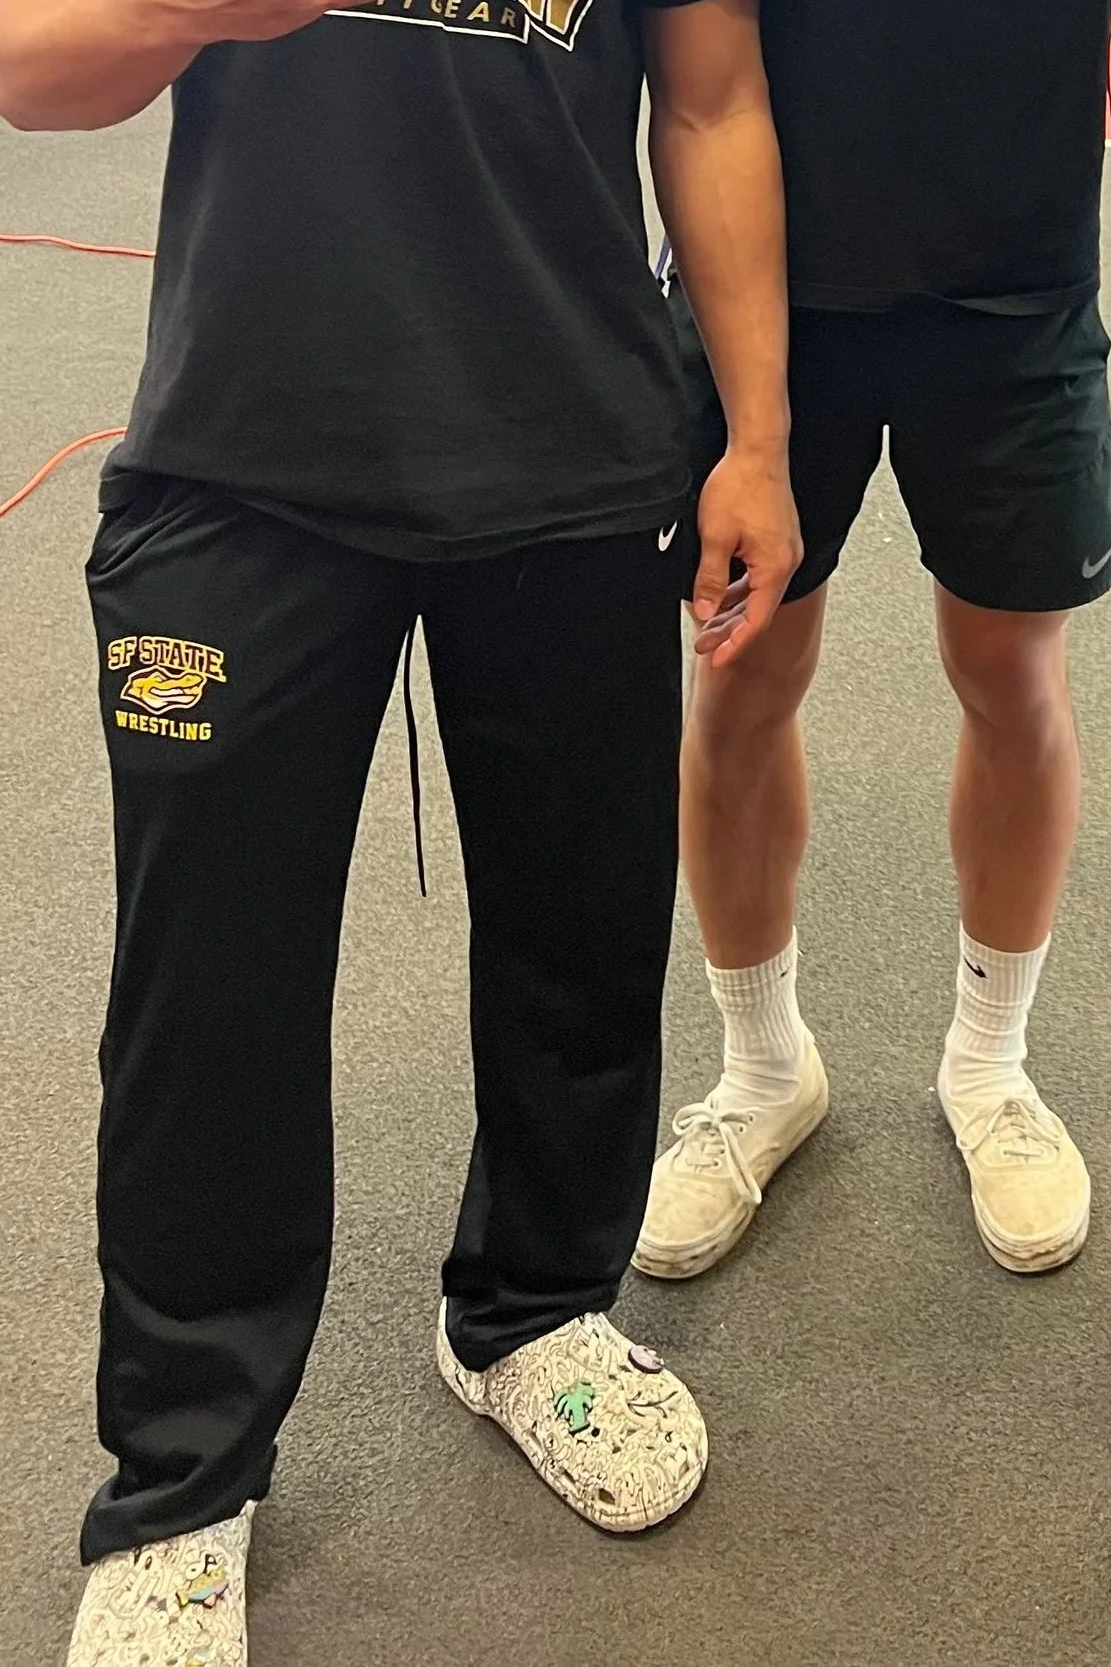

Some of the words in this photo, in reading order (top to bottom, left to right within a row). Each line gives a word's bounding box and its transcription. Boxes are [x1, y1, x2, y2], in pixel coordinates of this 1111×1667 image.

[107, 636, 137, 671] SF
[138, 635, 227, 683] STATE
[115, 710, 212, 742] WRESTLING
